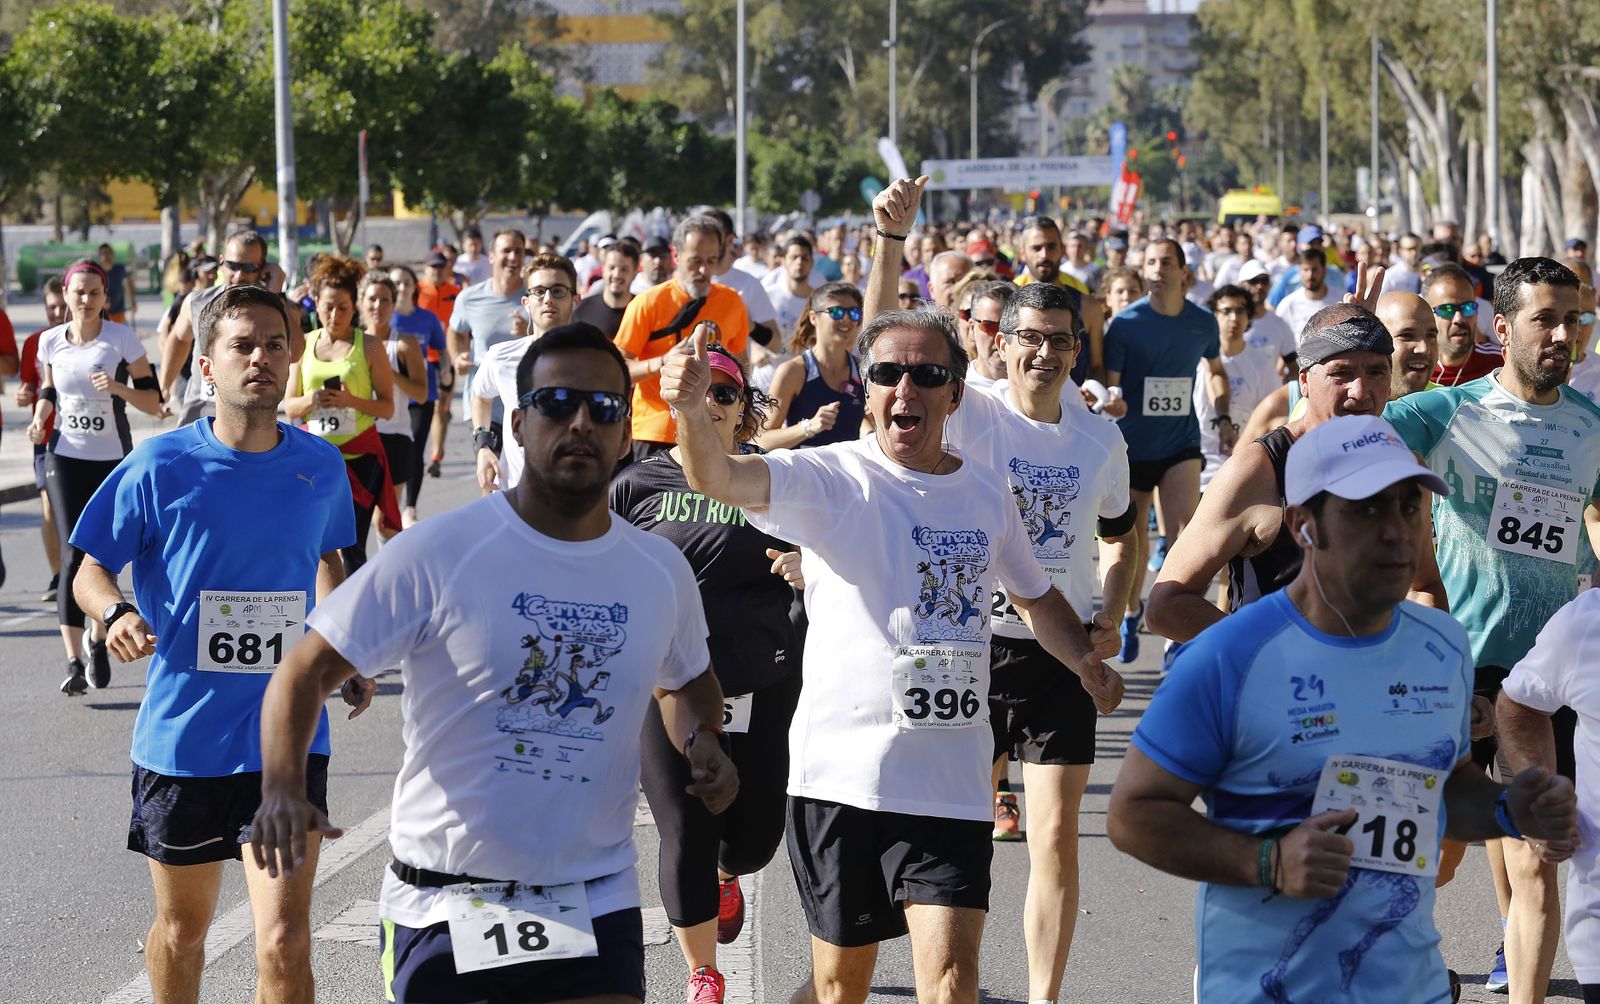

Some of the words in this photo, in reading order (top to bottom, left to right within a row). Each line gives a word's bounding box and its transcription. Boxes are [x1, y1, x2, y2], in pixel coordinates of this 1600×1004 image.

[1149, 397, 1182, 411] 633
[68, 415, 105, 431] 399
[1540, 438, 1549, 446] 27
[1017, 460, 1069, 478] Carrera
[1532, 459, 1572, 472] CaixaBank
[1515, 468, 1540, 478] Ciudad
[1540, 471, 1548, 480] de
[1549, 473, 1573, 485] Málaga
[1510, 483, 1541, 495] CARRERA
[1541, 489, 1551, 497] DE
[1560, 493, 1581, 503] PRENSA
[656, 491, 705, 522] JUST
[706, 497, 746, 527] RUN
[920, 526, 979, 546] Carrera
[1497, 516, 1565, 554] 845
[931, 542, 986, 556] Prensa
[526, 595, 612, 620] Carrera
[543, 616, 619, 637] Prensa
[208, 632, 283, 665] 681
[909, 648, 947, 656] CARRERA
[965, 650, 982, 658] PRENSA
[1388, 681, 1408, 697] edp
[903, 687, 980, 720] 396
[1331, 760, 1341, 768] IV
[1341, 760, 1385, 775] CARRERA
[1386, 766, 1396, 776] DE
[1397, 769, 1407, 777] LA
[451, 888, 460, 897] IV
[483, 920, 550, 956] 18
